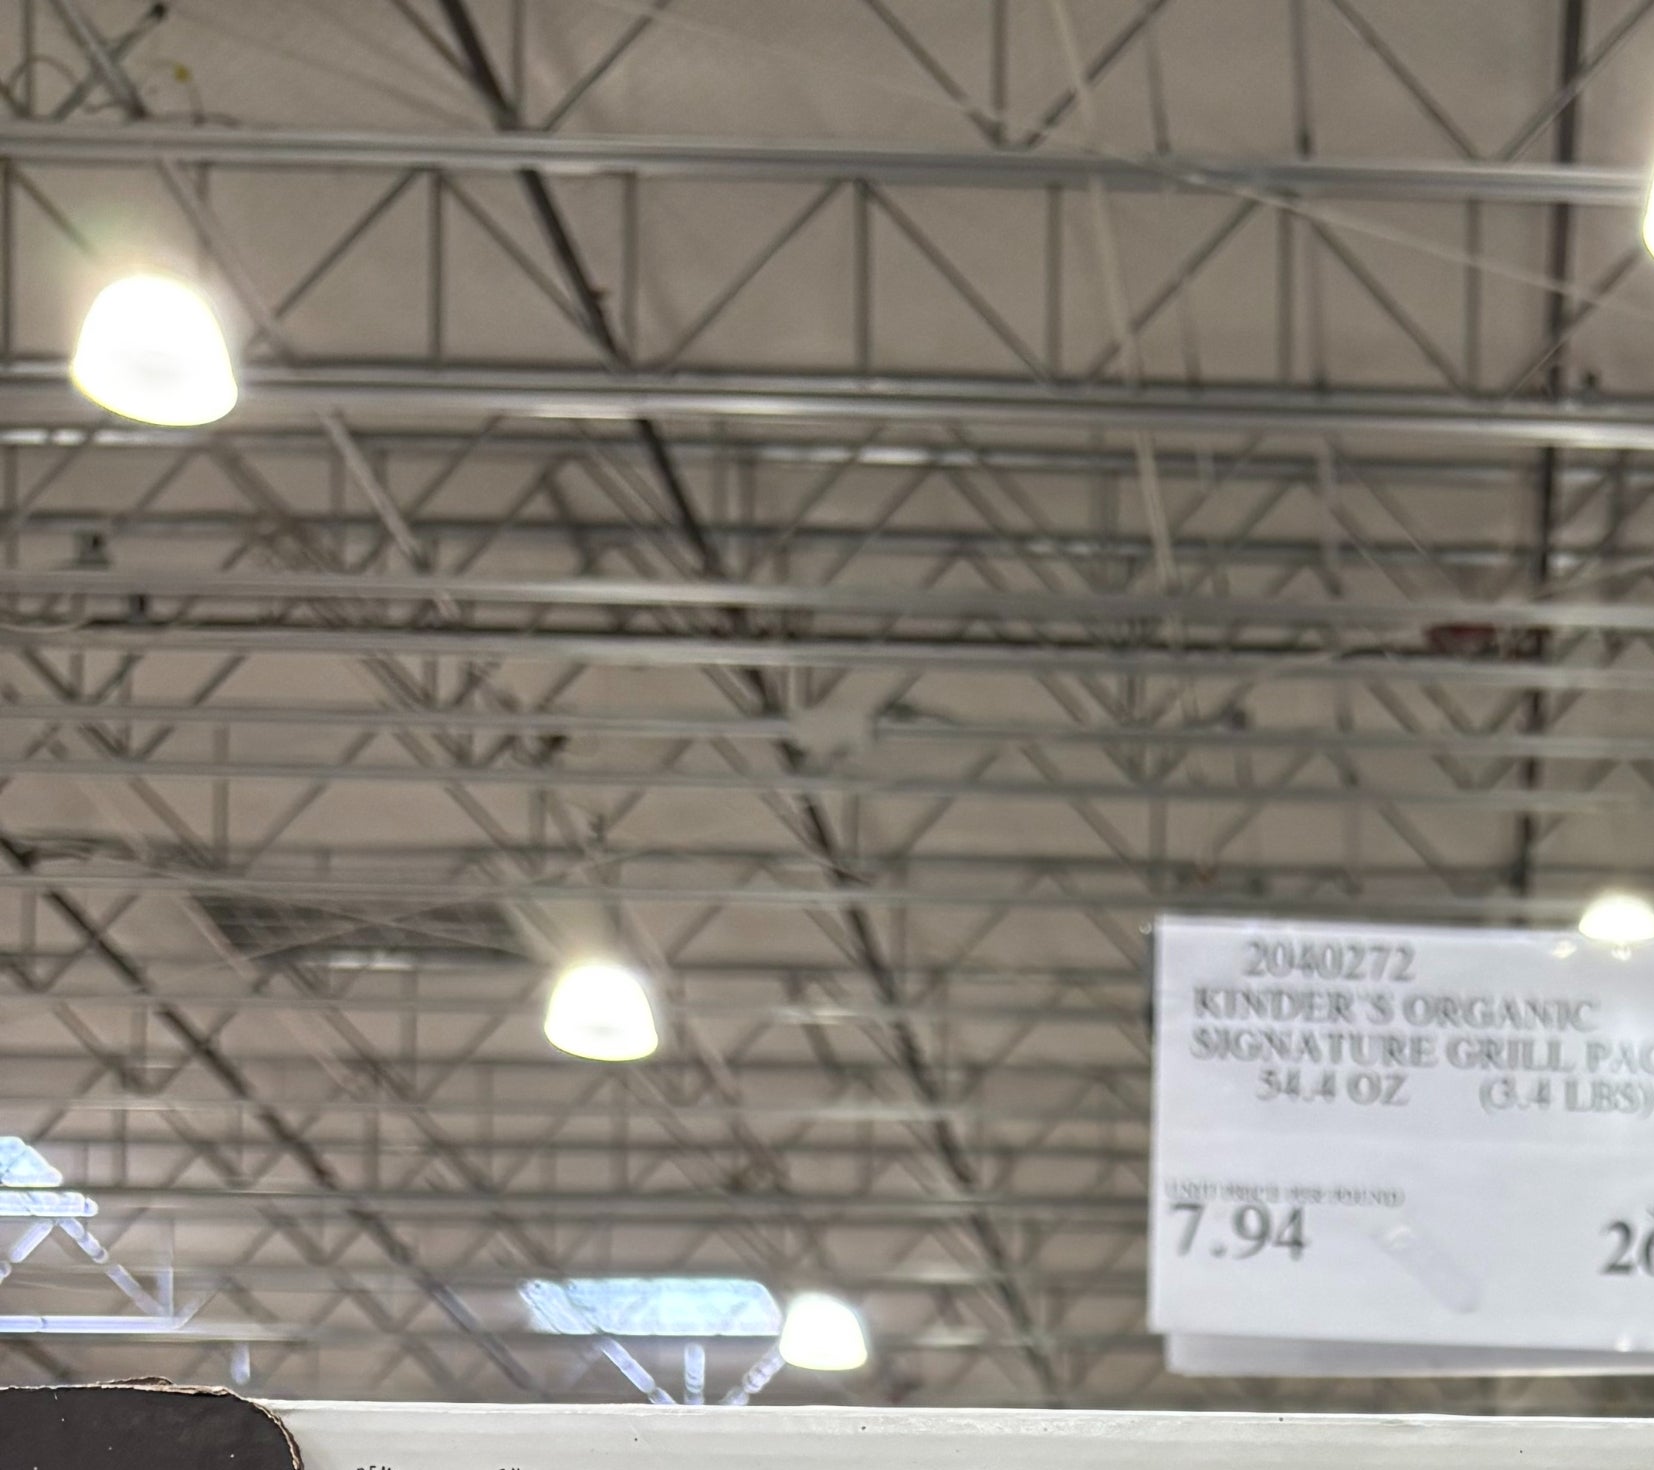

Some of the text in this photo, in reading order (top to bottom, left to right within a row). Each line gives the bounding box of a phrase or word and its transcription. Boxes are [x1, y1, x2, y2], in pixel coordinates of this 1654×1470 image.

[1243, 940, 1415, 981] 2040272
[1403, 997, 1601, 1032] ORGANIC
[1190, 1027, 1436, 1068] SIGNATURE
[1445, 1040, 1575, 1073] GRILL
[1347, 1073, 1410, 1107] OZ
[1170, 1202, 1308, 1261] 7.94
